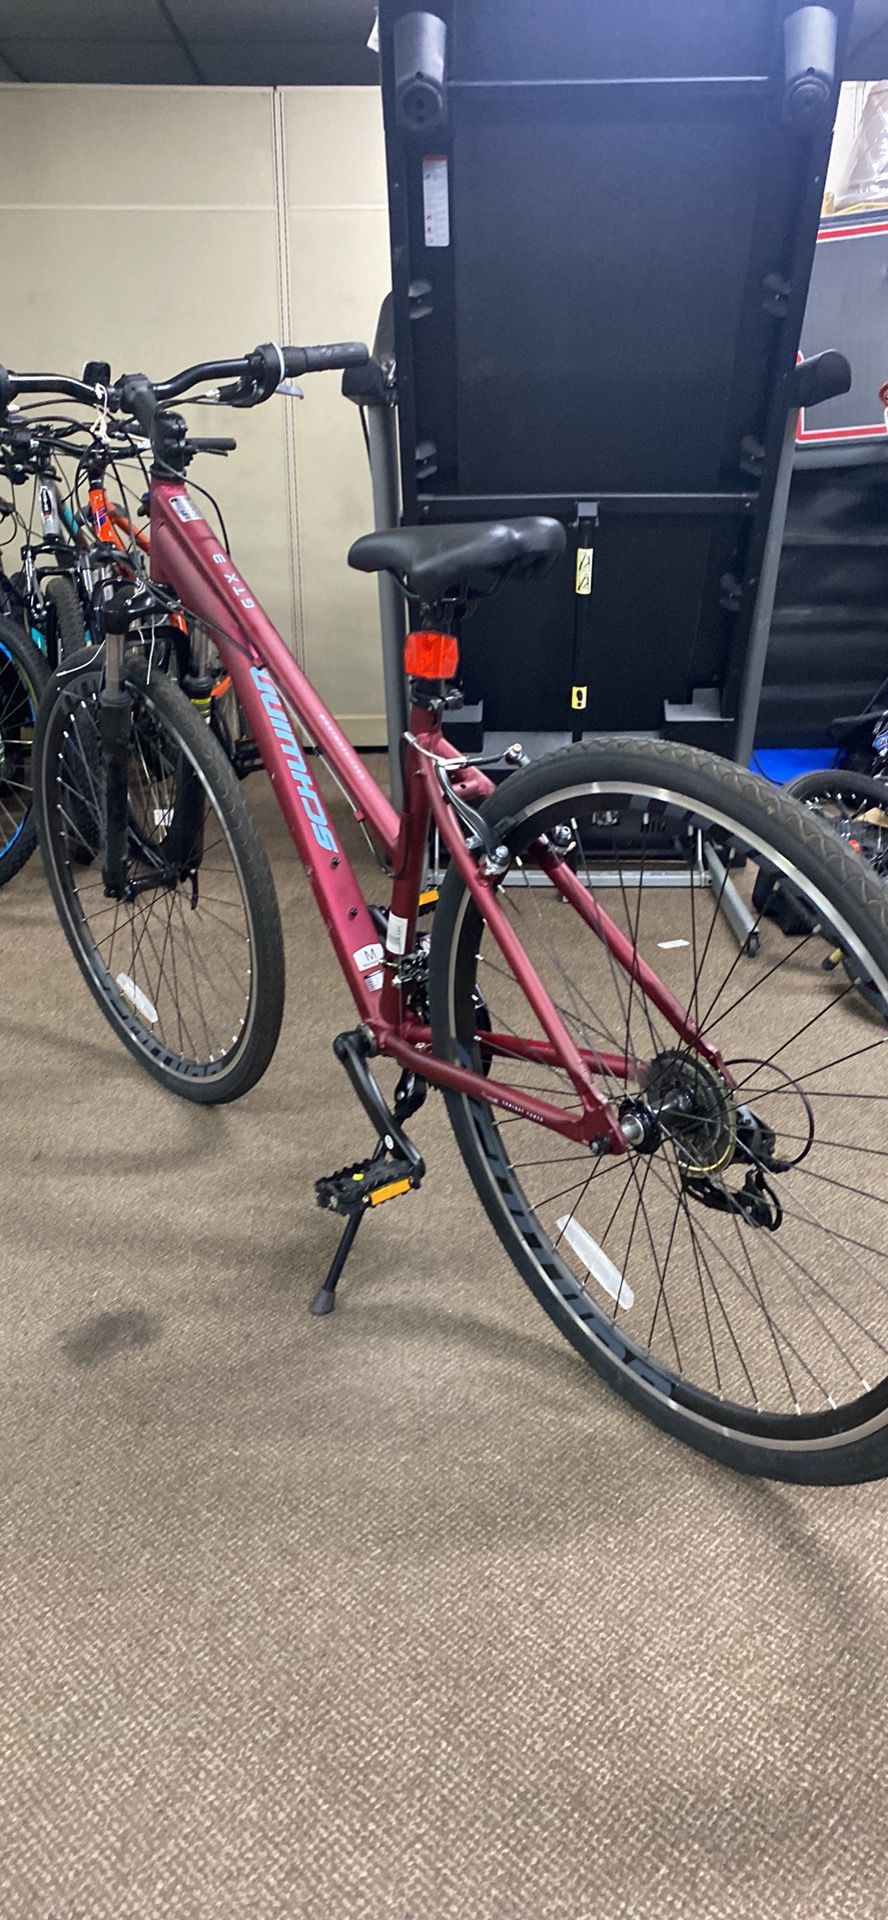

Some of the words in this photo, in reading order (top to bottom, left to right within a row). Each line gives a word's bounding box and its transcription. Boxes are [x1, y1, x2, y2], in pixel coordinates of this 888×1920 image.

[223, 572, 256, 609] GTX
[250, 666, 339, 854] SCHWINN
[364, 949, 377, 961] M
